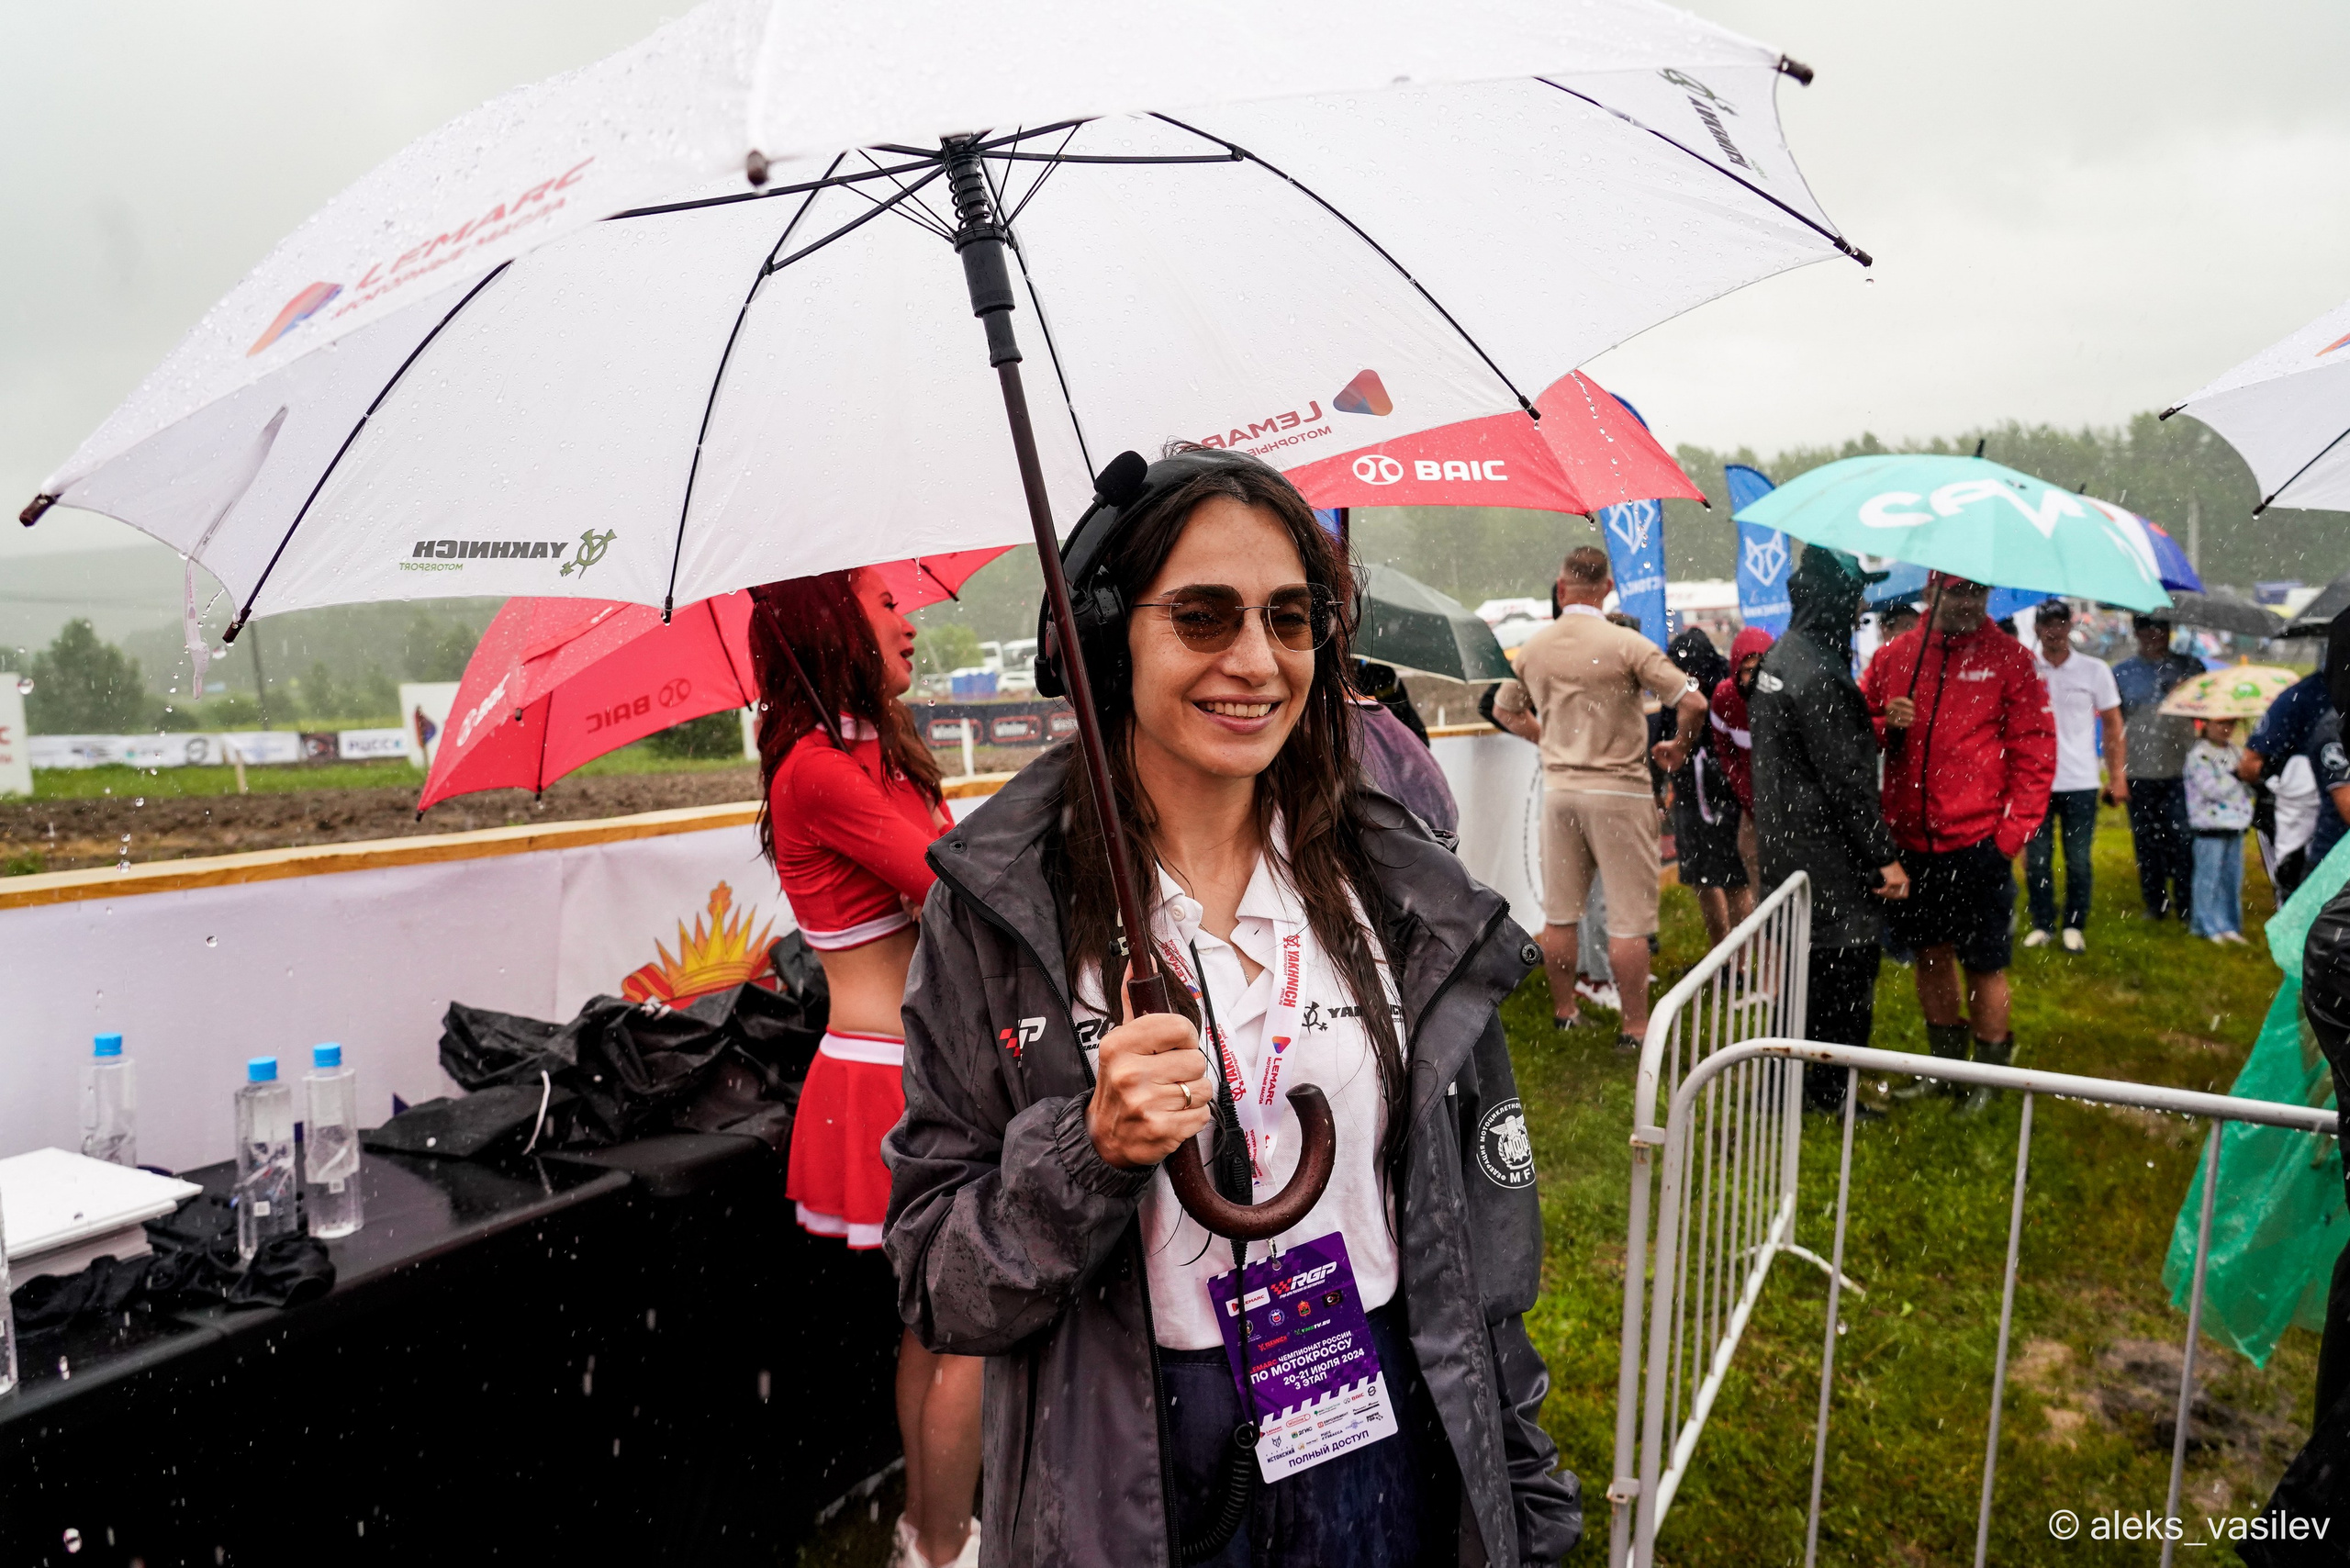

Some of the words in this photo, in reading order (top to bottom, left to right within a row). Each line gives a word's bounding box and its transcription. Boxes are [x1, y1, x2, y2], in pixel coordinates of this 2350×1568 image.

[355, 156, 595, 291] LEMARC
[1414, 460, 1508, 481] BAIC
[1282, 950, 1300, 1008] YAKHNICH
[1259, 1088, 1267, 1104] МАСЛА
[1265, 1057, 1282, 1105] LEMARC
[1480, 1145, 1506, 1181] ФЕДЕРАЦИЯ
[1291, 1261, 1337, 1290] RGP
[1245, 1294, 1264, 1305] EMARC
[1250, 1371, 1269, 1384] ПО
[1270, 1338, 1352, 1376] МОТОКРОССУ
[1278, 1342, 1321, 1362] ЧЕМПИОНАТ
[1322, 1330, 1351, 1347] РОССИИ
[1283, 1369, 1309, 1385] 20-21
[1311, 1358, 1340, 1374] ИЮЛЯ
[1341, 1348, 1365, 1363] 2024
[1294, 1382, 1301, 1390] 3
[1303, 1372, 1327, 1386] ЭТАП
[1298, 1426, 1313, 1436] 2ГИС
[1267, 1447, 1295, 1463] ИСТОКСКИЙ
[1289, 1444, 1330, 1468] ПОЛНЫЙ
[1332, 1430, 1370, 1452] ДОСТУП
